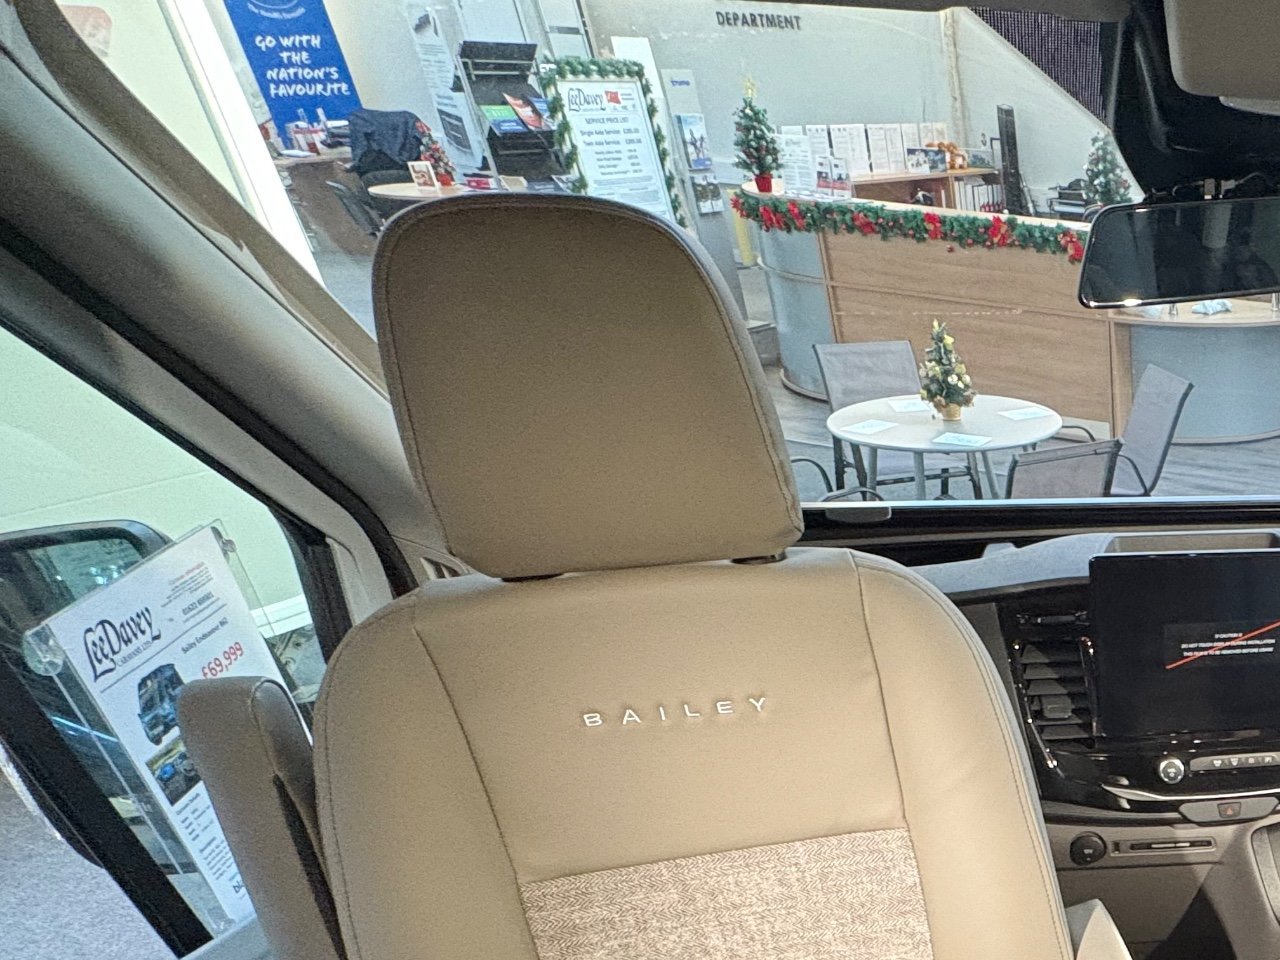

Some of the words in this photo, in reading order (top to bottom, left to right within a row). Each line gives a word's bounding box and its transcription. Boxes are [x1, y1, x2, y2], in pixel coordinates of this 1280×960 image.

[716, 11, 801, 30] DEPARTMENT
[255, 35, 276, 51] GO
[279, 34, 321, 48] WITH
[279, 51, 311, 64] THE
[267, 67, 339, 80] NATION'S
[269, 82, 351, 98] FAVOURITE
[202, 641, 244, 679] £69,999
[583, 697, 766, 727] BAILEY
